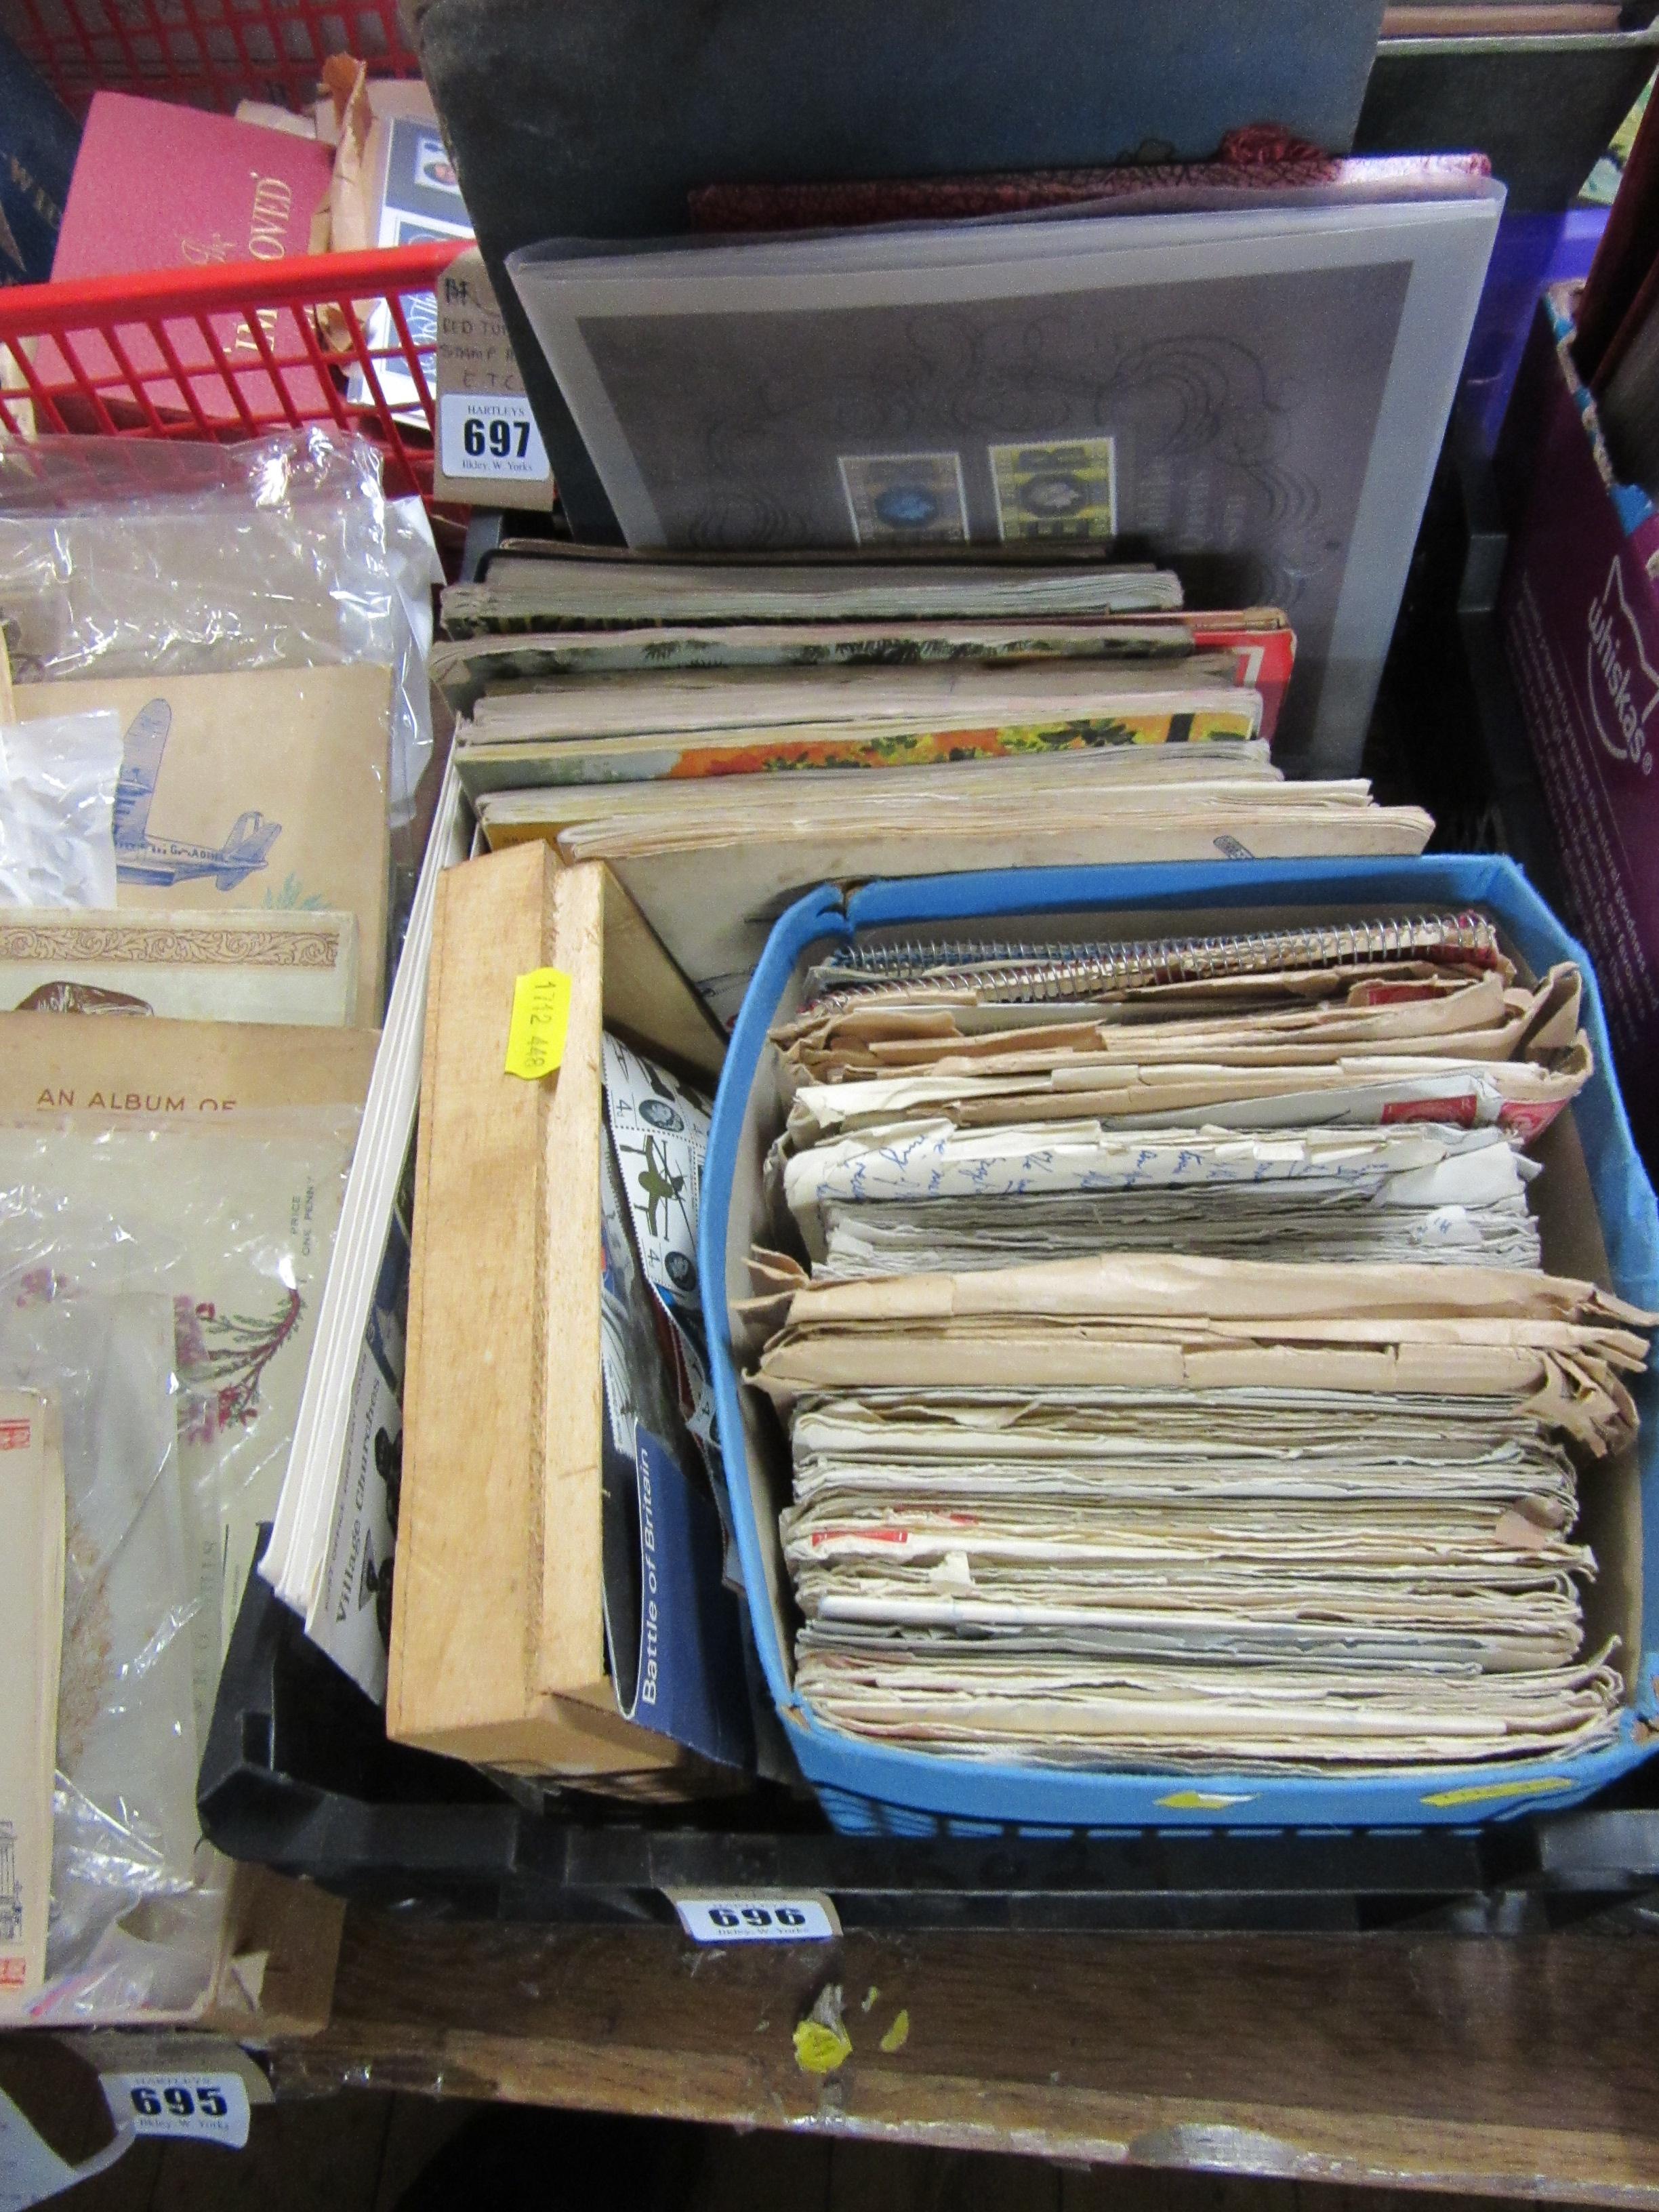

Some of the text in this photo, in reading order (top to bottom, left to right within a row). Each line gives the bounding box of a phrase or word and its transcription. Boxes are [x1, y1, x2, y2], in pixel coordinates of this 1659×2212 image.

[468, 405, 525, 417] HARTLEYS
[464, 419, 531, 458] 697
[1588, 596, 1645, 764] whiskas
[37, 1088, 75, 1107] AN
[87, 1092, 186, 1112] ALBUM
[336, 1376, 380, 1623] Village Churches
[640, 1447, 658, 1706] Battle of Britain
[708, 1906, 806, 1927] 696
[130, 2086, 228, 2116] 695
